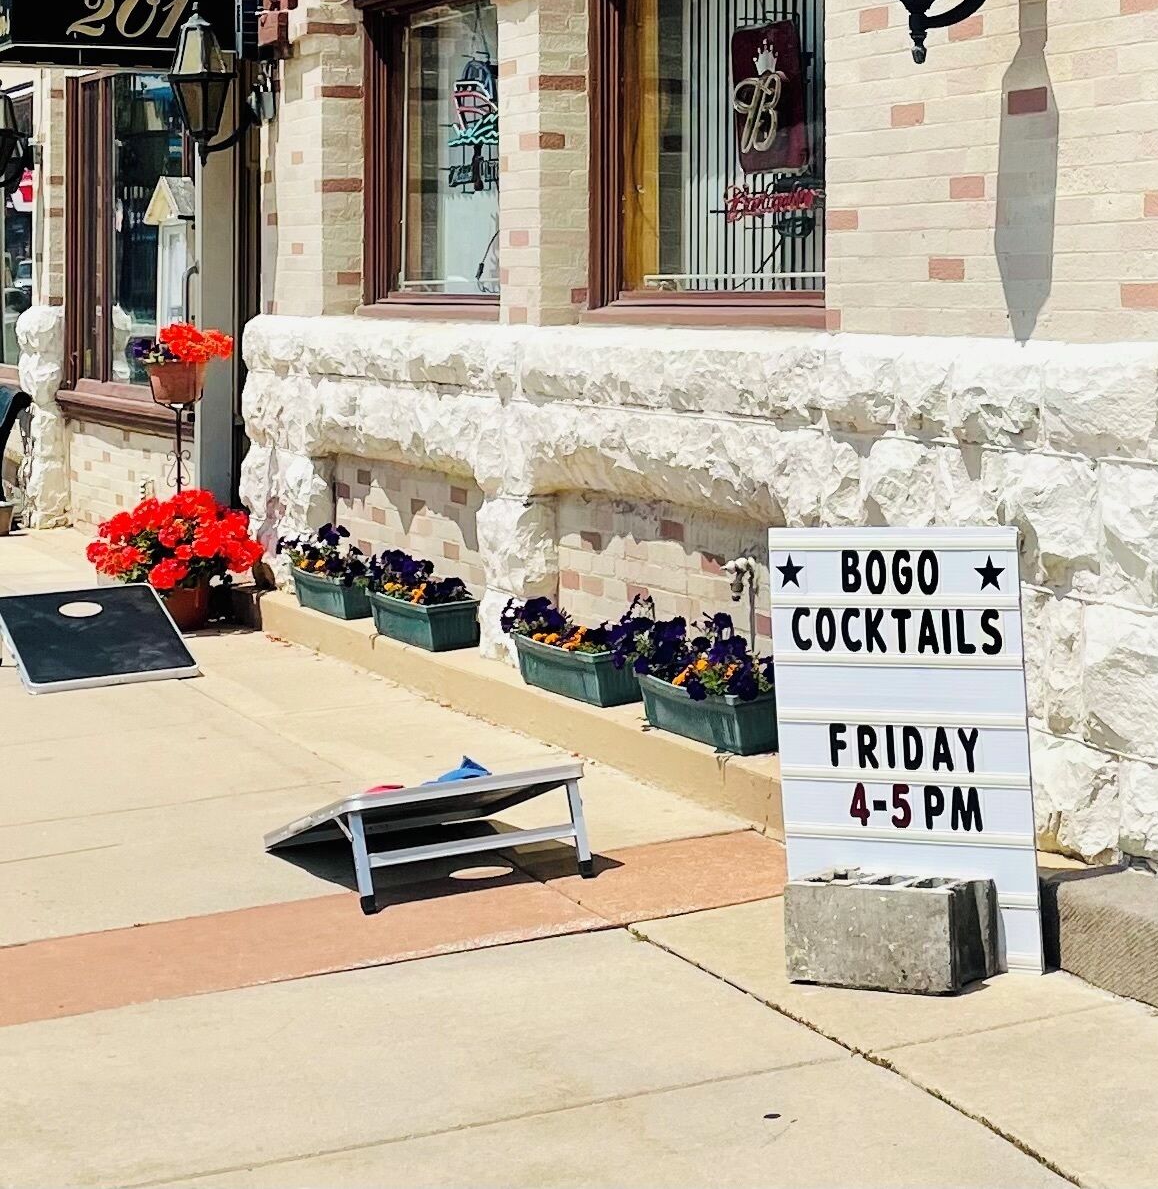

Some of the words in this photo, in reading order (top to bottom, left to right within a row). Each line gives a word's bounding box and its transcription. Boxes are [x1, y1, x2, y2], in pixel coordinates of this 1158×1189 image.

[841, 549, 940, 596] BOGO
[791, 607, 1004, 655] COCKTAILS
[828, 723, 980, 773] FRIDAY
